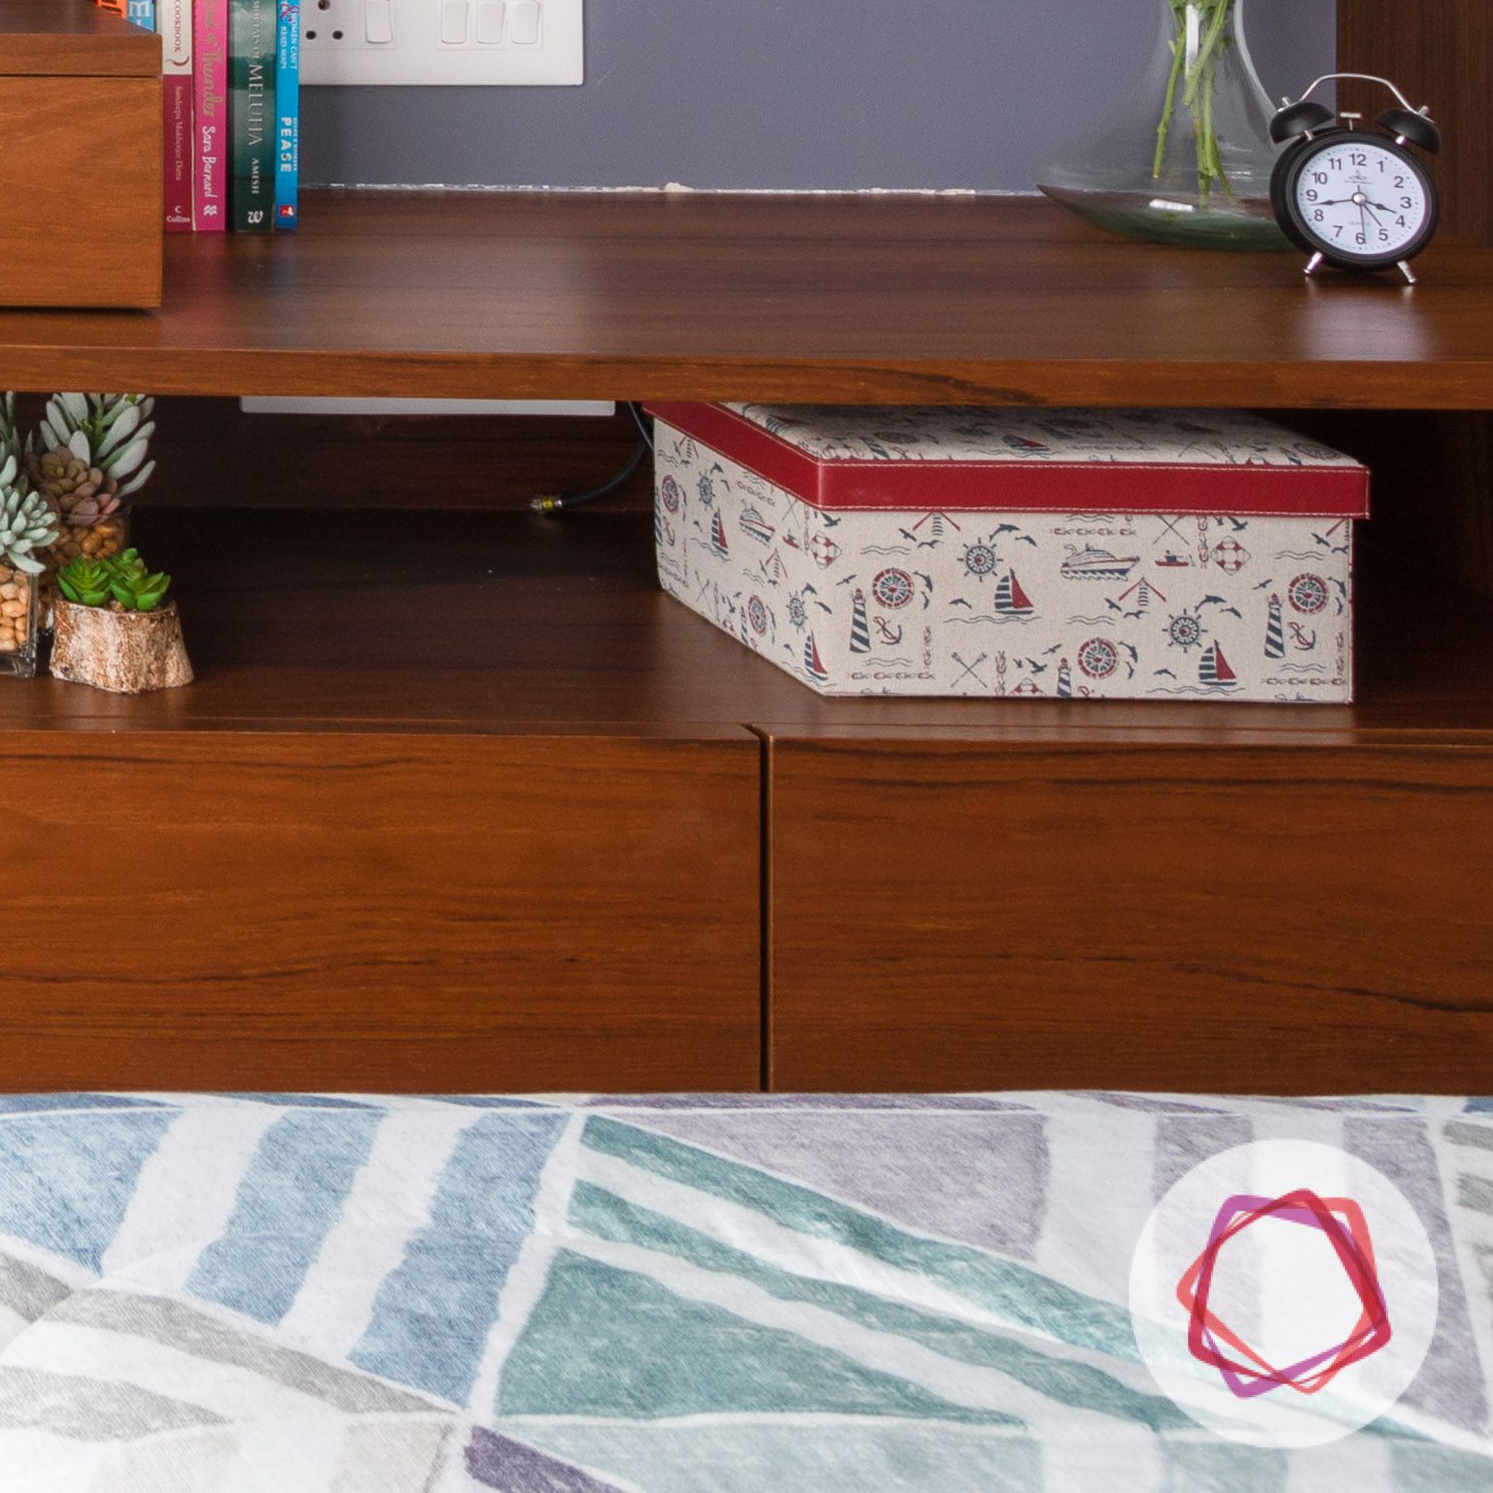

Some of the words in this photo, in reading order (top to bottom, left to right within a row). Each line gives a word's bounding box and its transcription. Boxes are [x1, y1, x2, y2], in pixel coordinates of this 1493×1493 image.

[173, 0, 182, 53] COOKBOOK
[291, 12, 299, 44] WOMEN
[291, 45, 299, 69] CAN'T
[248, 63, 264, 146] MELUHA
[202, 126, 216, 153] Sara
[280, 117, 292, 172] PEASE
[1328, 158, 1342, 170] 11
[1348, 153, 1367, 167] 12
[1377, 160, 1384, 173] 1
[201, 156, 218, 198] Barnard
[250, 158, 260, 195] AMISH
[1312, 172, 1328, 185] 10
[1394, 176, 1404, 188] 2
[1306, 189, 1318, 201] 9
[1400, 196, 1412, 209] 3
[1314, 209, 1324, 222] 8
[1395, 215, 1405, 227] 4
[1333, 225, 1343, 238] 7
[1378, 228, 1388, 241] 5
[1355, 232, 1365, 245] 6
